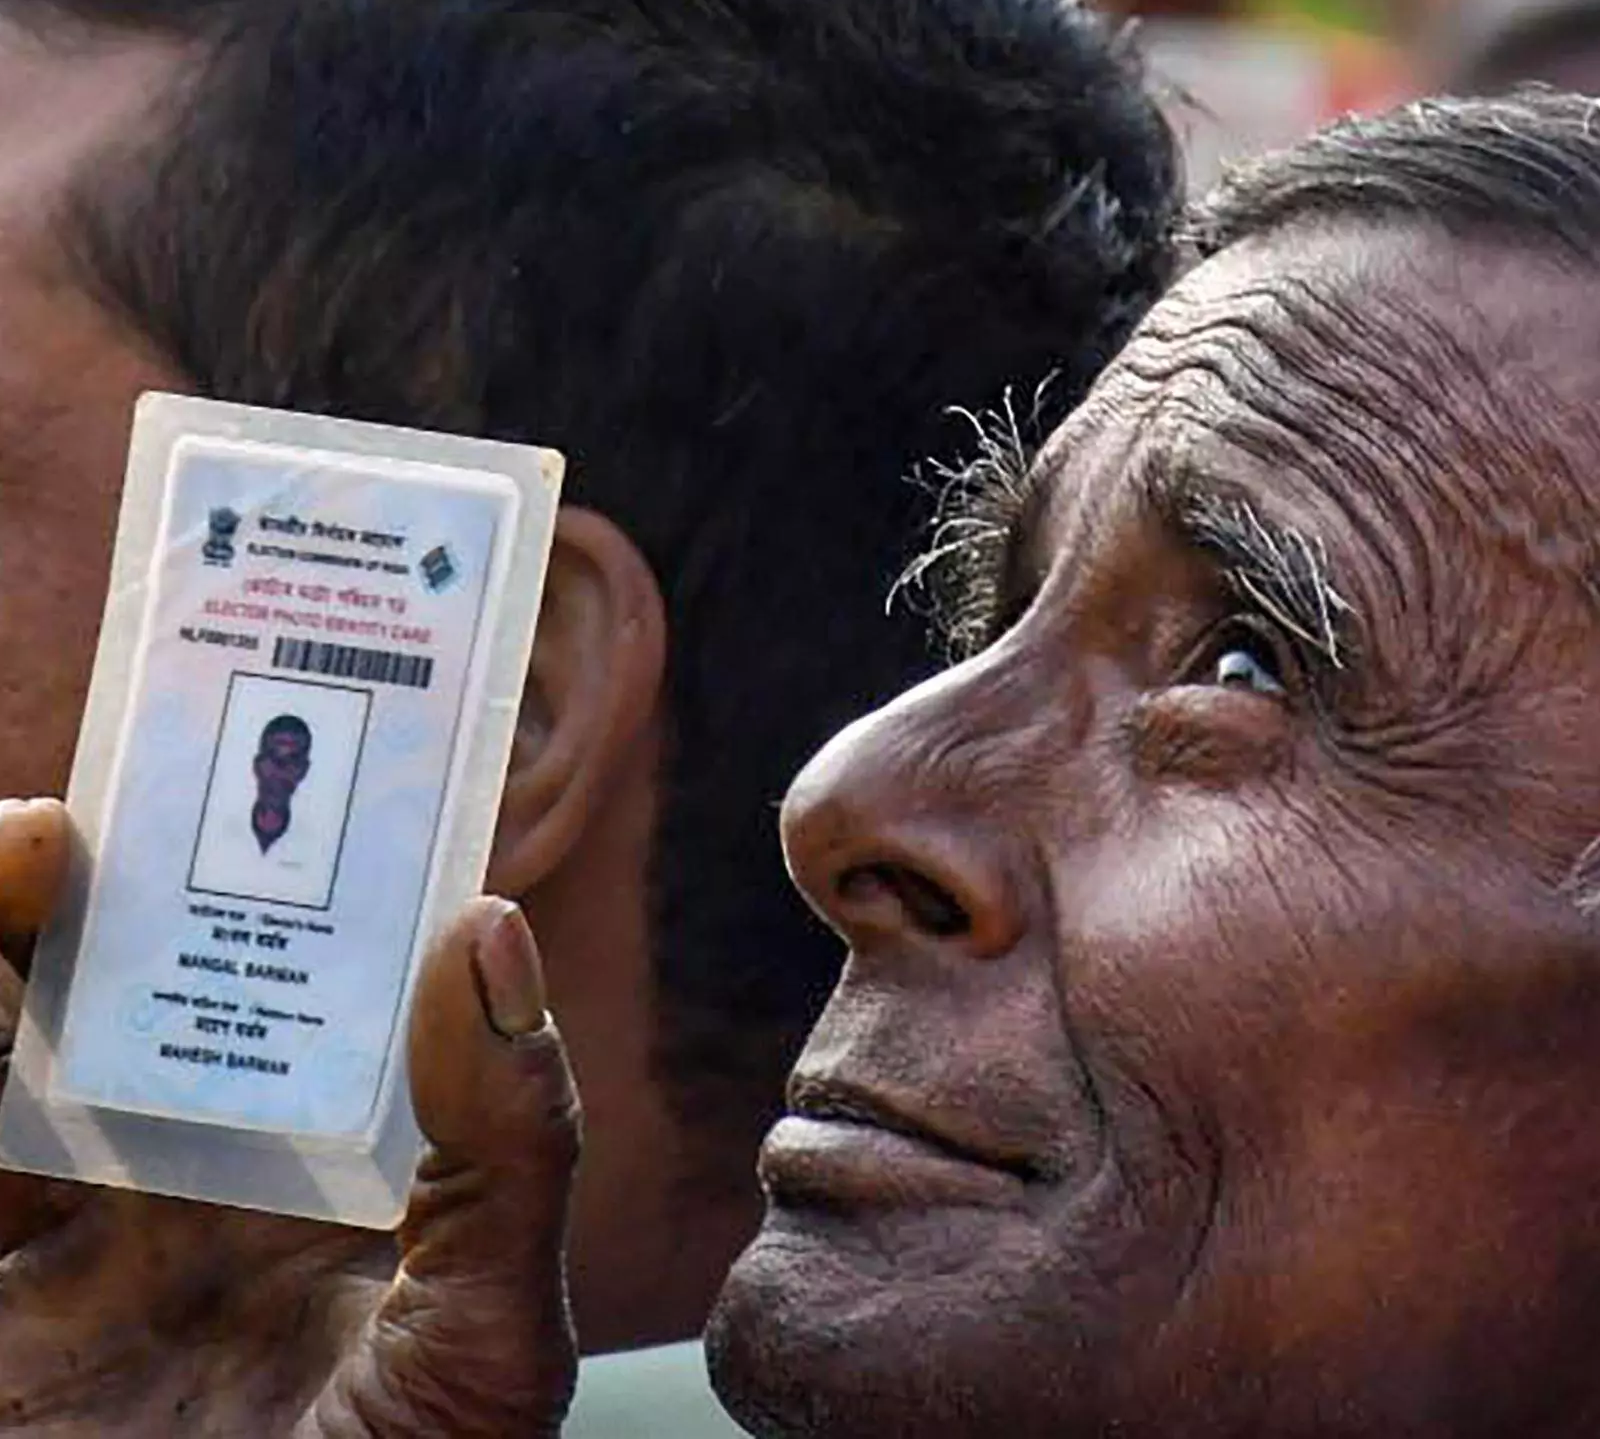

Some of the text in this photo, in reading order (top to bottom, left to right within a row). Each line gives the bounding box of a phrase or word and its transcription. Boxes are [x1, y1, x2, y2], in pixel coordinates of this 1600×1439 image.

[247, 542, 295, 559] ELECTION
[204, 599, 432, 643] ELECTOR PHOTO IDENTITY CARD
[178, 953, 310, 984] MANGAL BARMAN
[160, 1043, 291, 1075] MAHESH BARMAN
